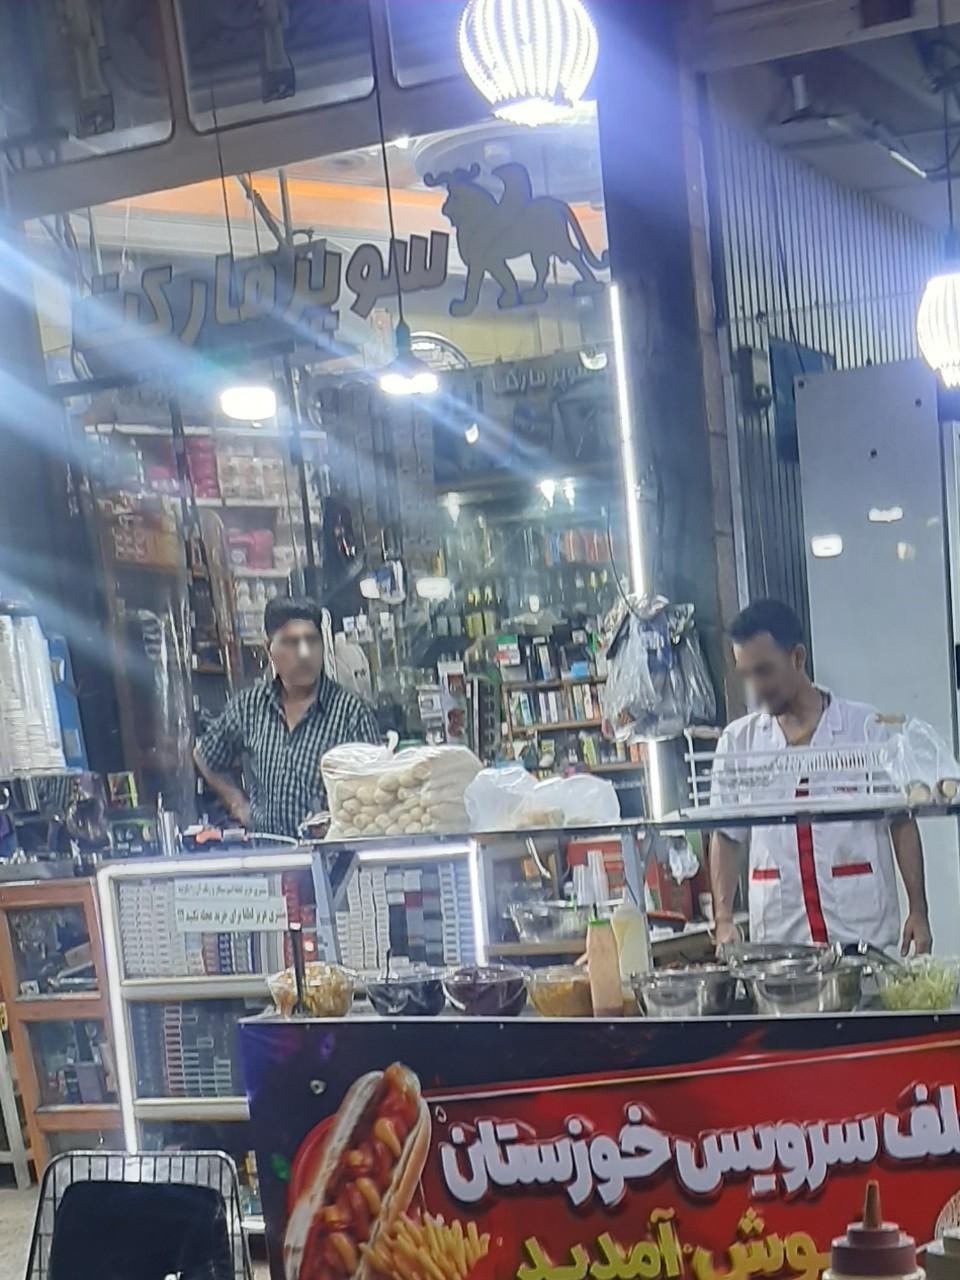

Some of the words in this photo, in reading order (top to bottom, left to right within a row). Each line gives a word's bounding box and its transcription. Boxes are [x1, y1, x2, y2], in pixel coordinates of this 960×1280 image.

[281, 231, 449, 333] سوپر
[440, 1103, 674, 1206] خوزستان
[676, 1113, 880, 1198] سرویس
